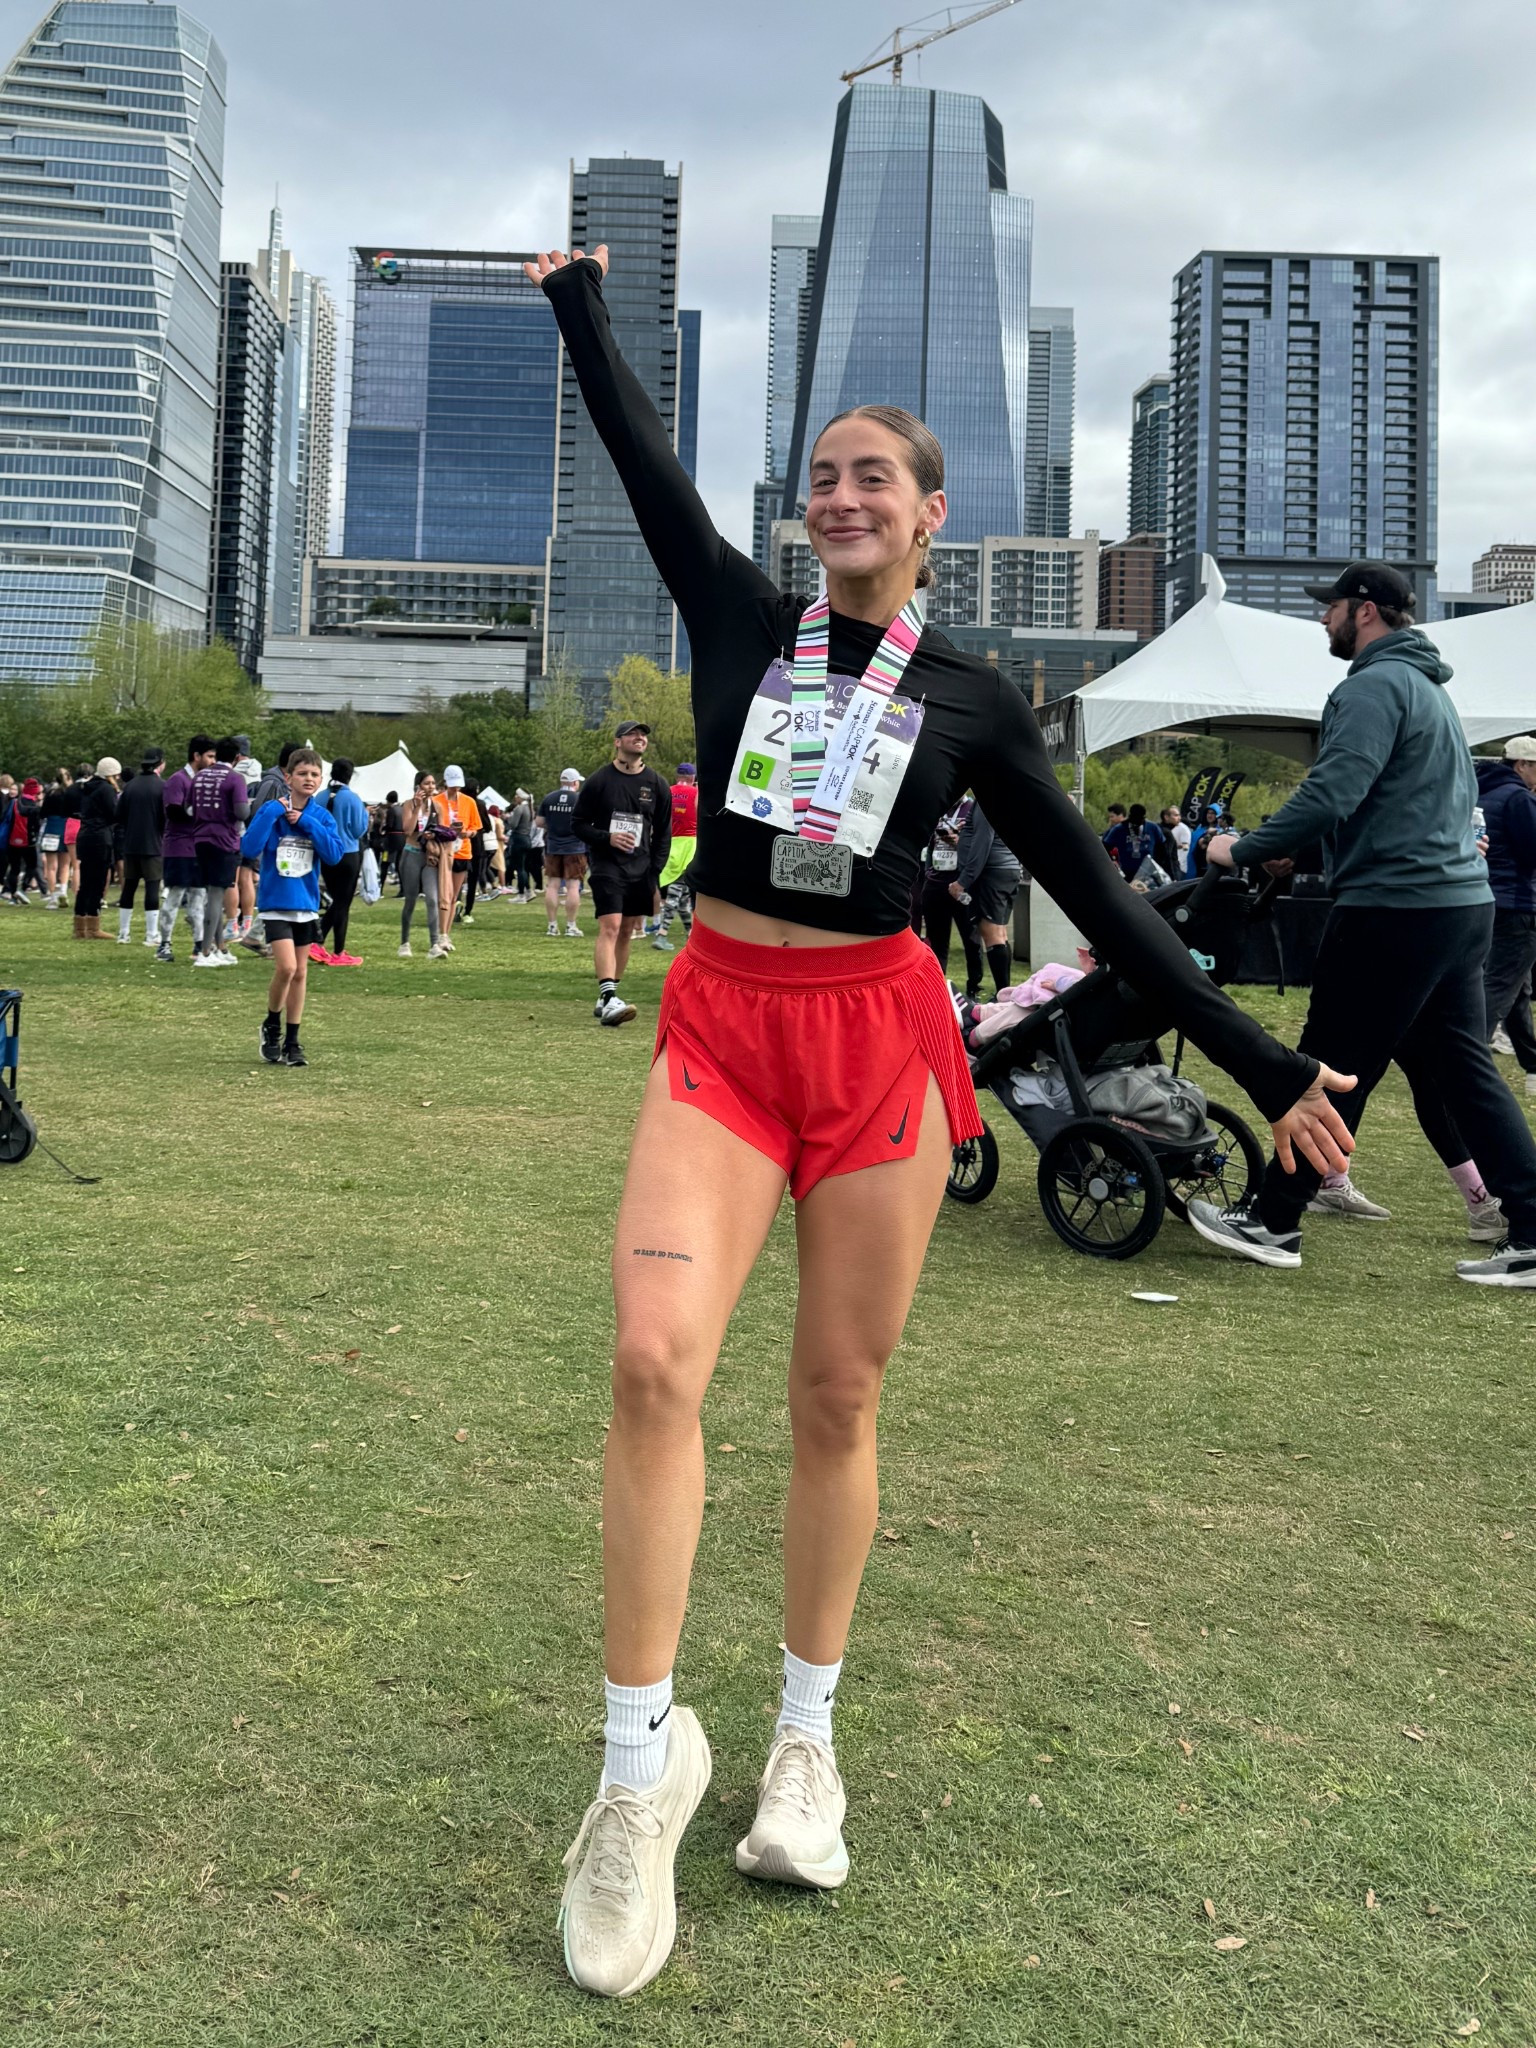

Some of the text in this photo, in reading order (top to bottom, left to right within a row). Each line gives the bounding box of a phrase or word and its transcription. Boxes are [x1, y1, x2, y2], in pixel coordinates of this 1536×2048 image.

[793, 710, 803, 732] 10K
[804, 710, 814, 732] CAP
[746, 759, 764, 780] B
[1187, 774, 1211, 822] CAP10K
[1216, 778, 1237, 814] AP10K
[777, 845, 806, 859] CAP10K
